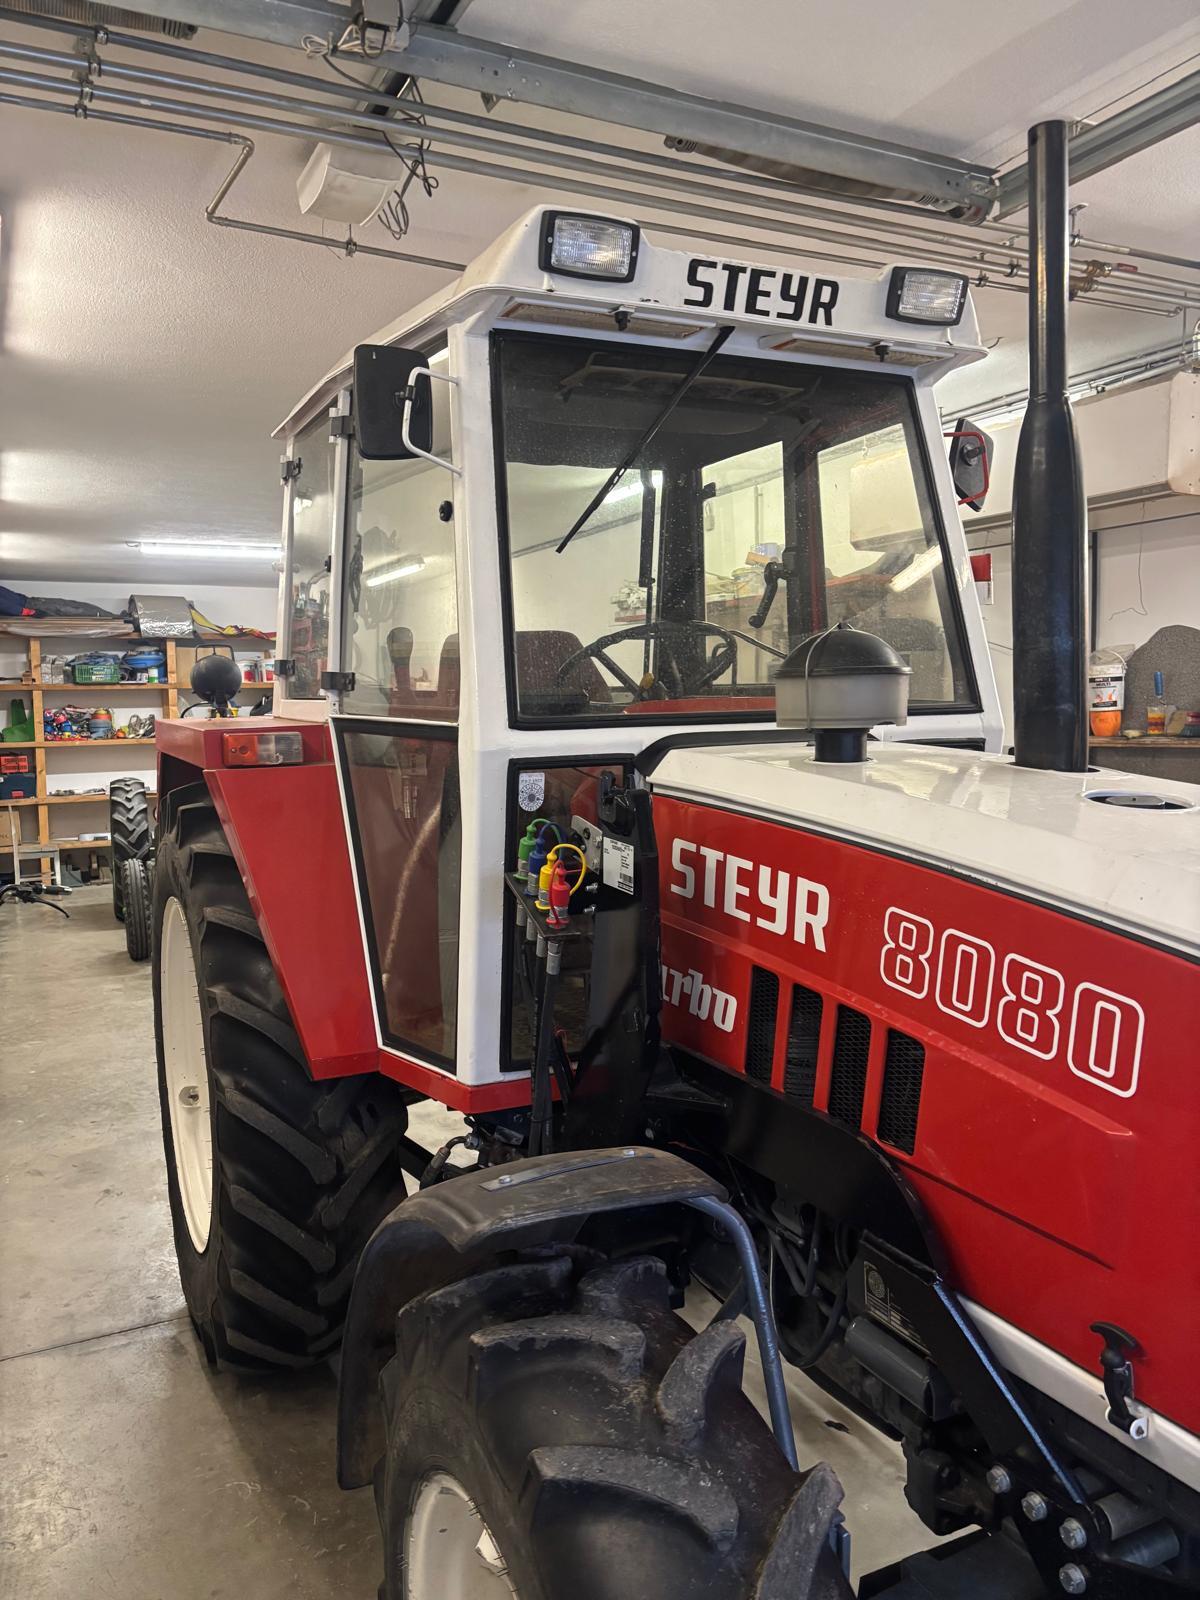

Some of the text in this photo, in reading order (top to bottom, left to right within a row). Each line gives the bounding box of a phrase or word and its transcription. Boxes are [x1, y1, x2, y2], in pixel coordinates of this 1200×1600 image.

[684, 258, 839, 326] STEYR
[670, 837, 830, 953] STEYR
[880, 906, 1145, 1098] 8080
